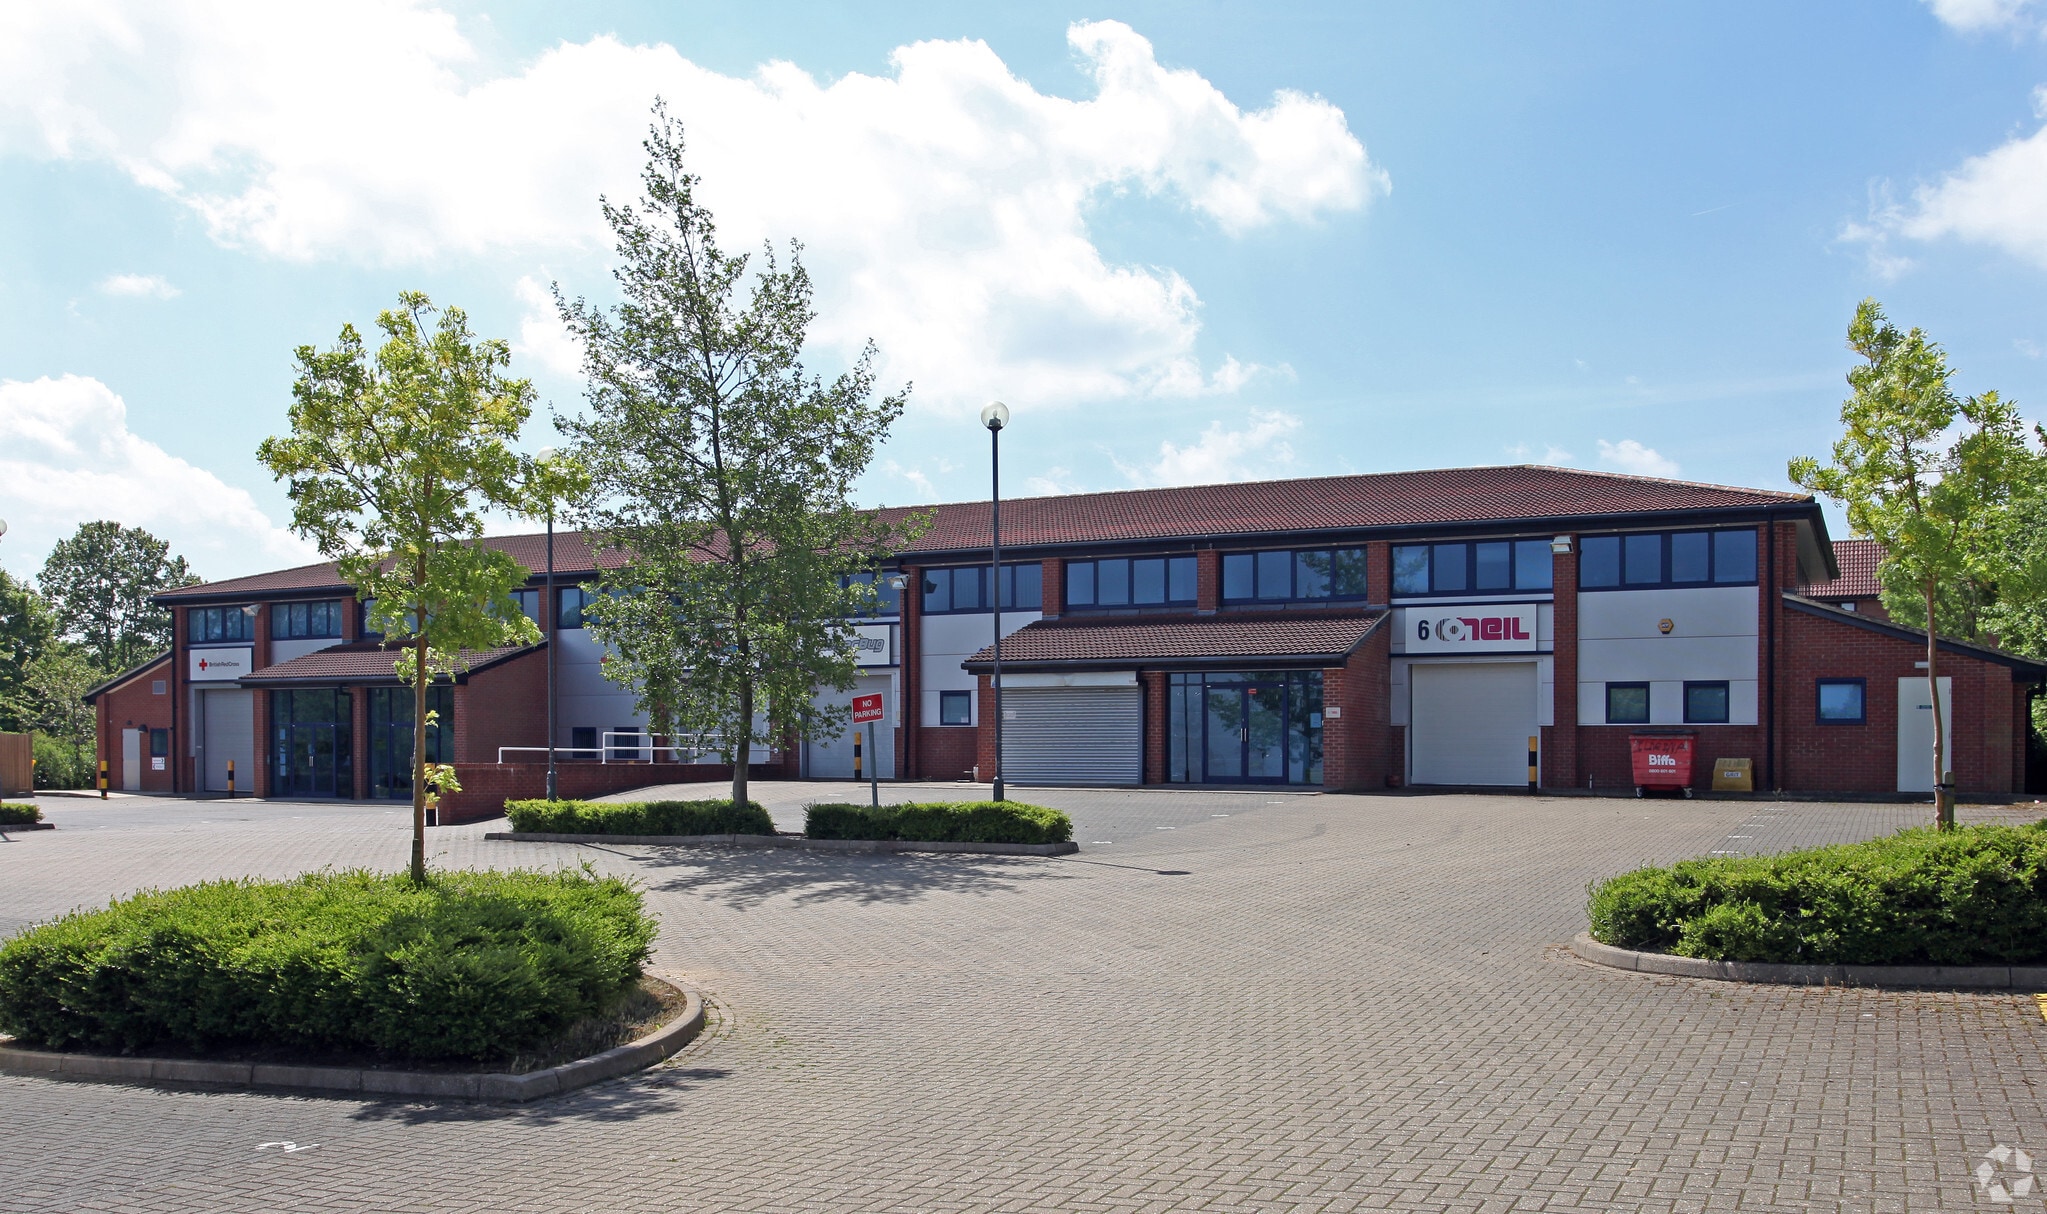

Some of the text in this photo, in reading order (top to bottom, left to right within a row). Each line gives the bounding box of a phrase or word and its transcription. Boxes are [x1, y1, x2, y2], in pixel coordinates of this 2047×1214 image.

[1418, 619, 1430, 641] 6
[862, 699, 873, 708] NO
[854, 708, 882, 719] PARKING
[1648, 754, 1676, 766] Biffa
